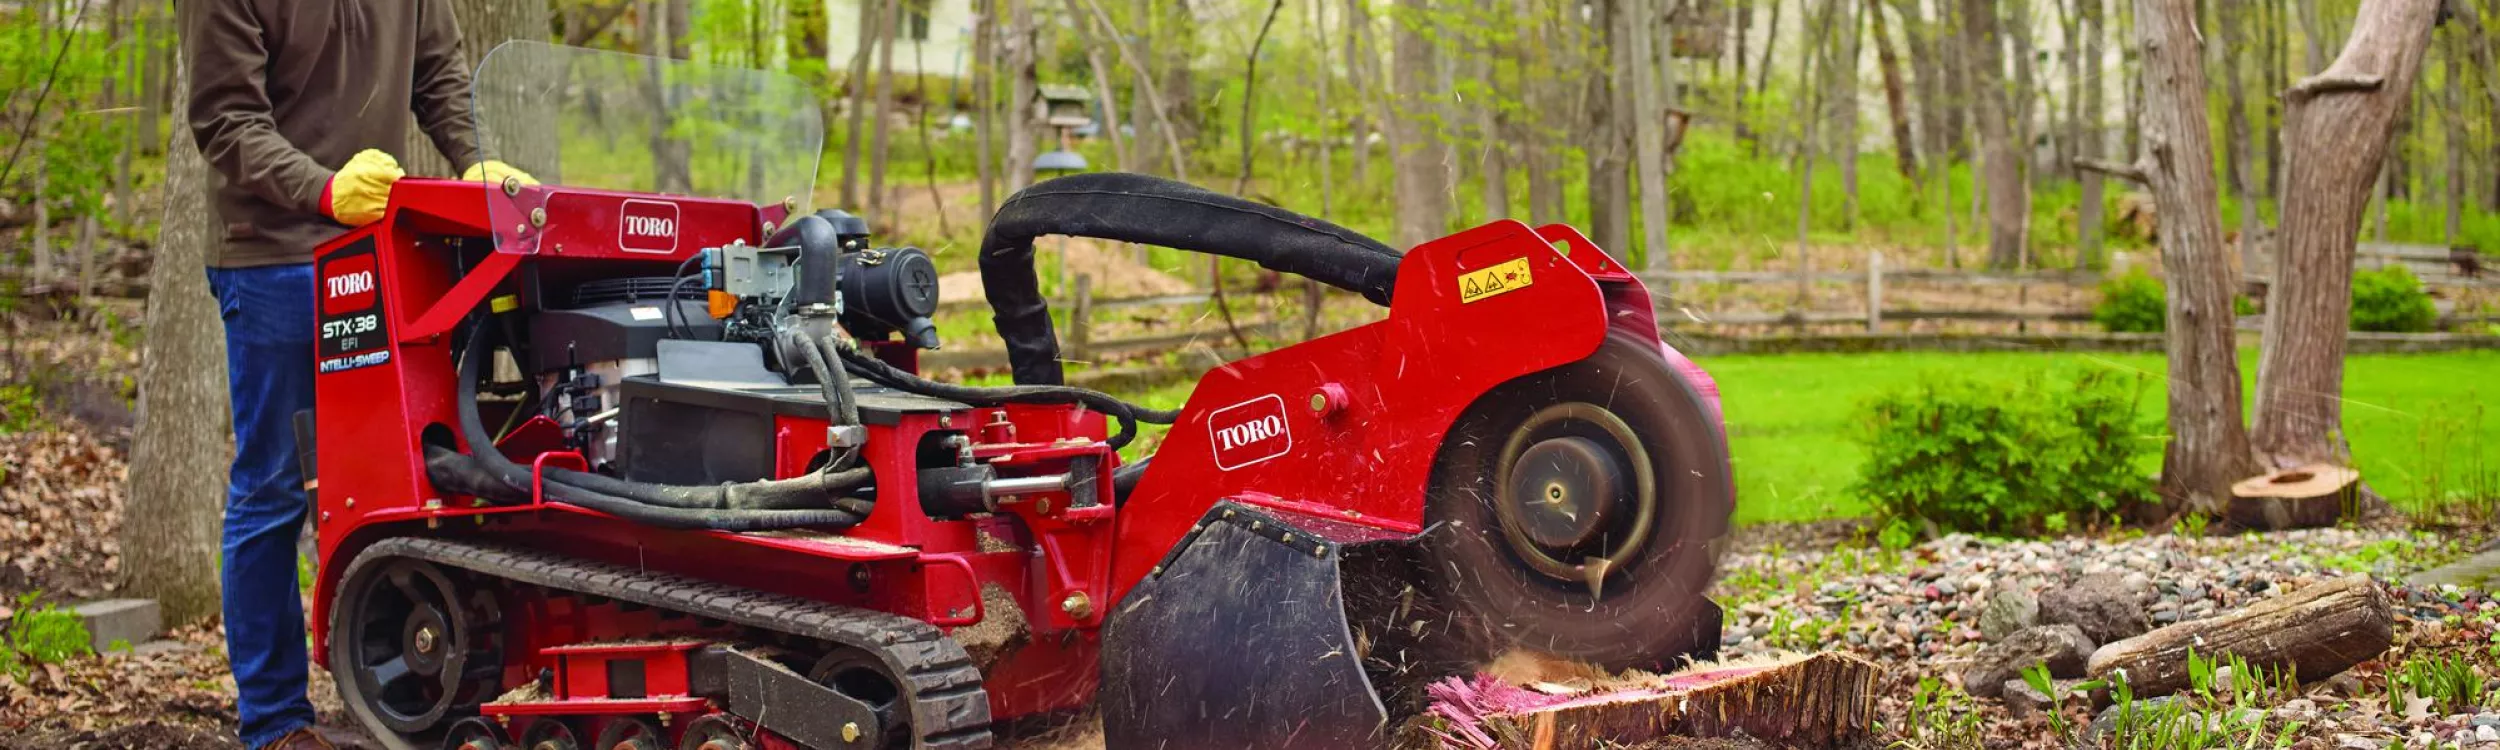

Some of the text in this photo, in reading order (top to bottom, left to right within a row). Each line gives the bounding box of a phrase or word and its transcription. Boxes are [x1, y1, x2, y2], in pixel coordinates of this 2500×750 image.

[625, 215, 673, 237] TORO
[327, 270, 374, 298] TORO
[341, 337, 358, 351] EFI
[1216, 415, 1284, 451] TORO
